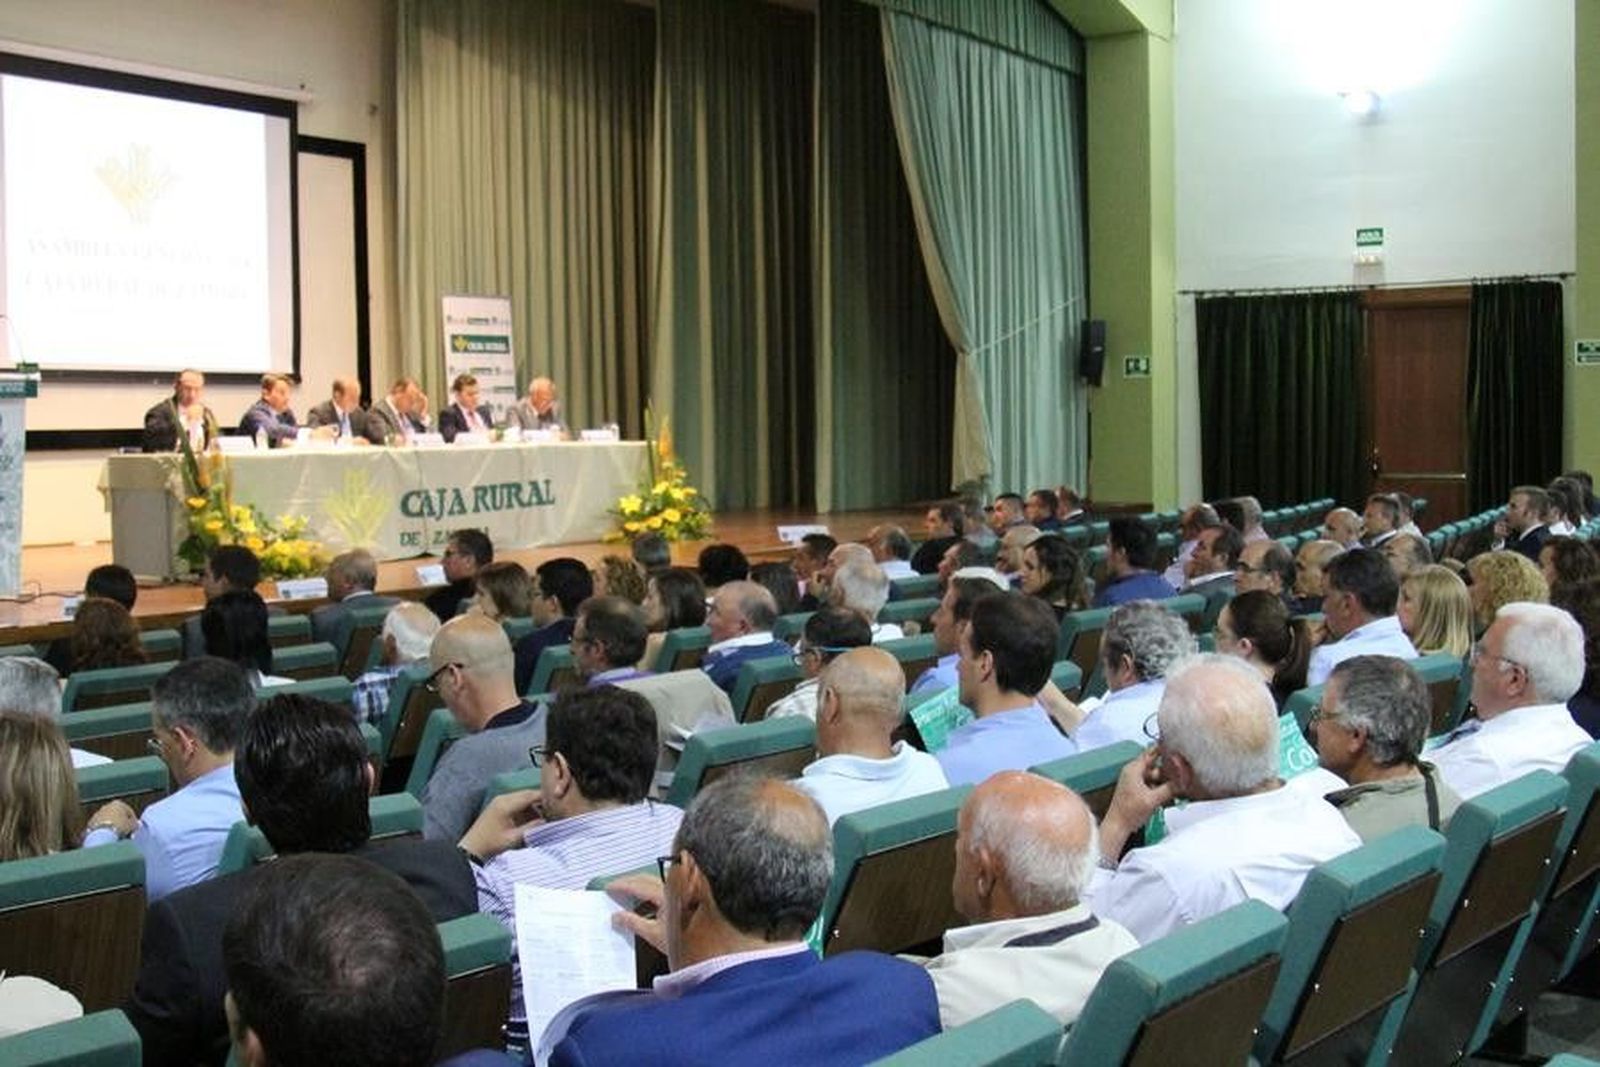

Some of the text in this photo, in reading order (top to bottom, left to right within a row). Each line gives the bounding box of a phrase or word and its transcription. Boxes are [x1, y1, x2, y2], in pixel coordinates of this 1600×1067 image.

[400, 479, 556, 521] CAJA RURAL
[400, 531, 421, 546] DE
